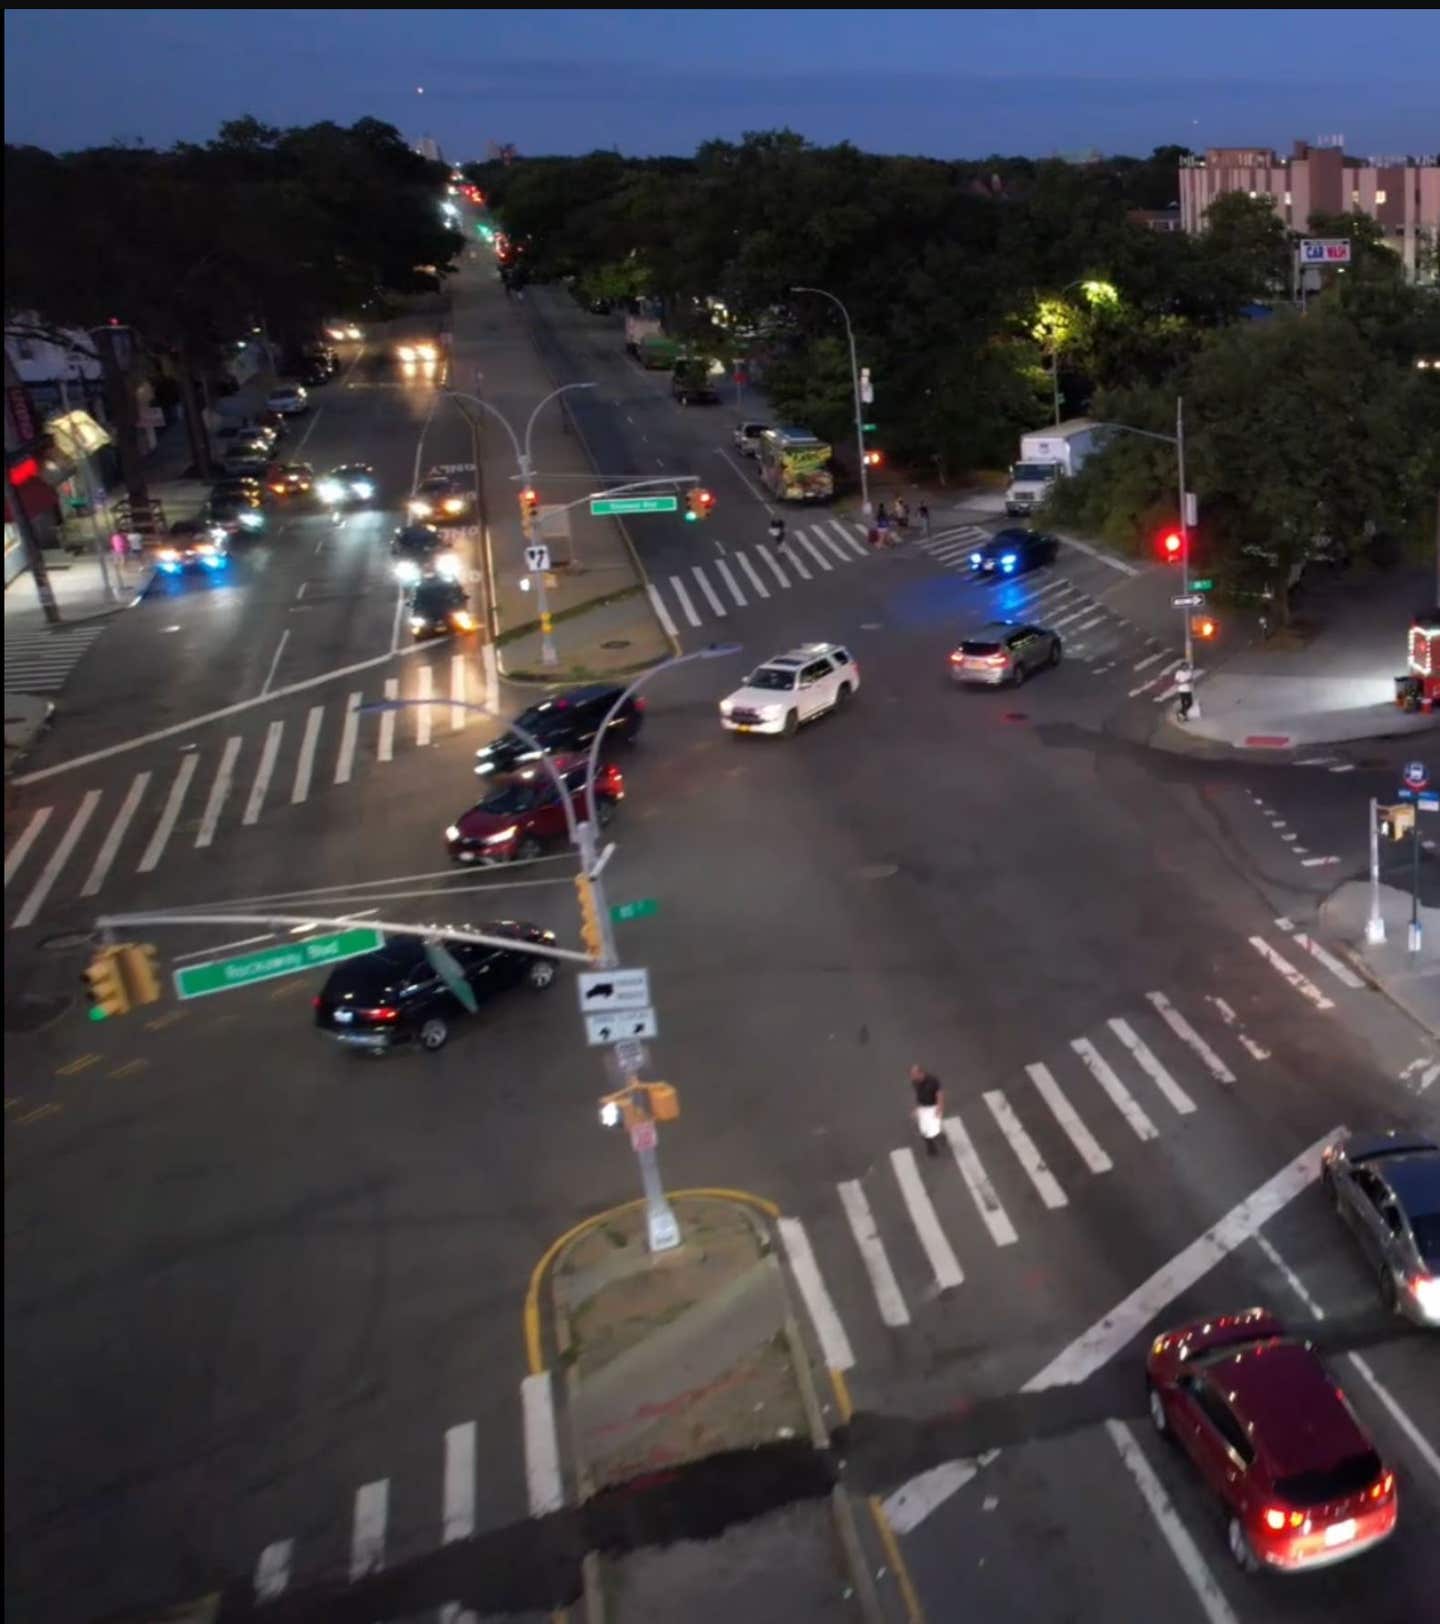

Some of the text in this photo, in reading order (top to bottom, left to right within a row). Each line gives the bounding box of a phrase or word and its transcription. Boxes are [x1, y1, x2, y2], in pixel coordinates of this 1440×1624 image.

[1306, 245, 1347, 259] CAR WASH
[224, 940, 339, 980] Rockaway Blvd
